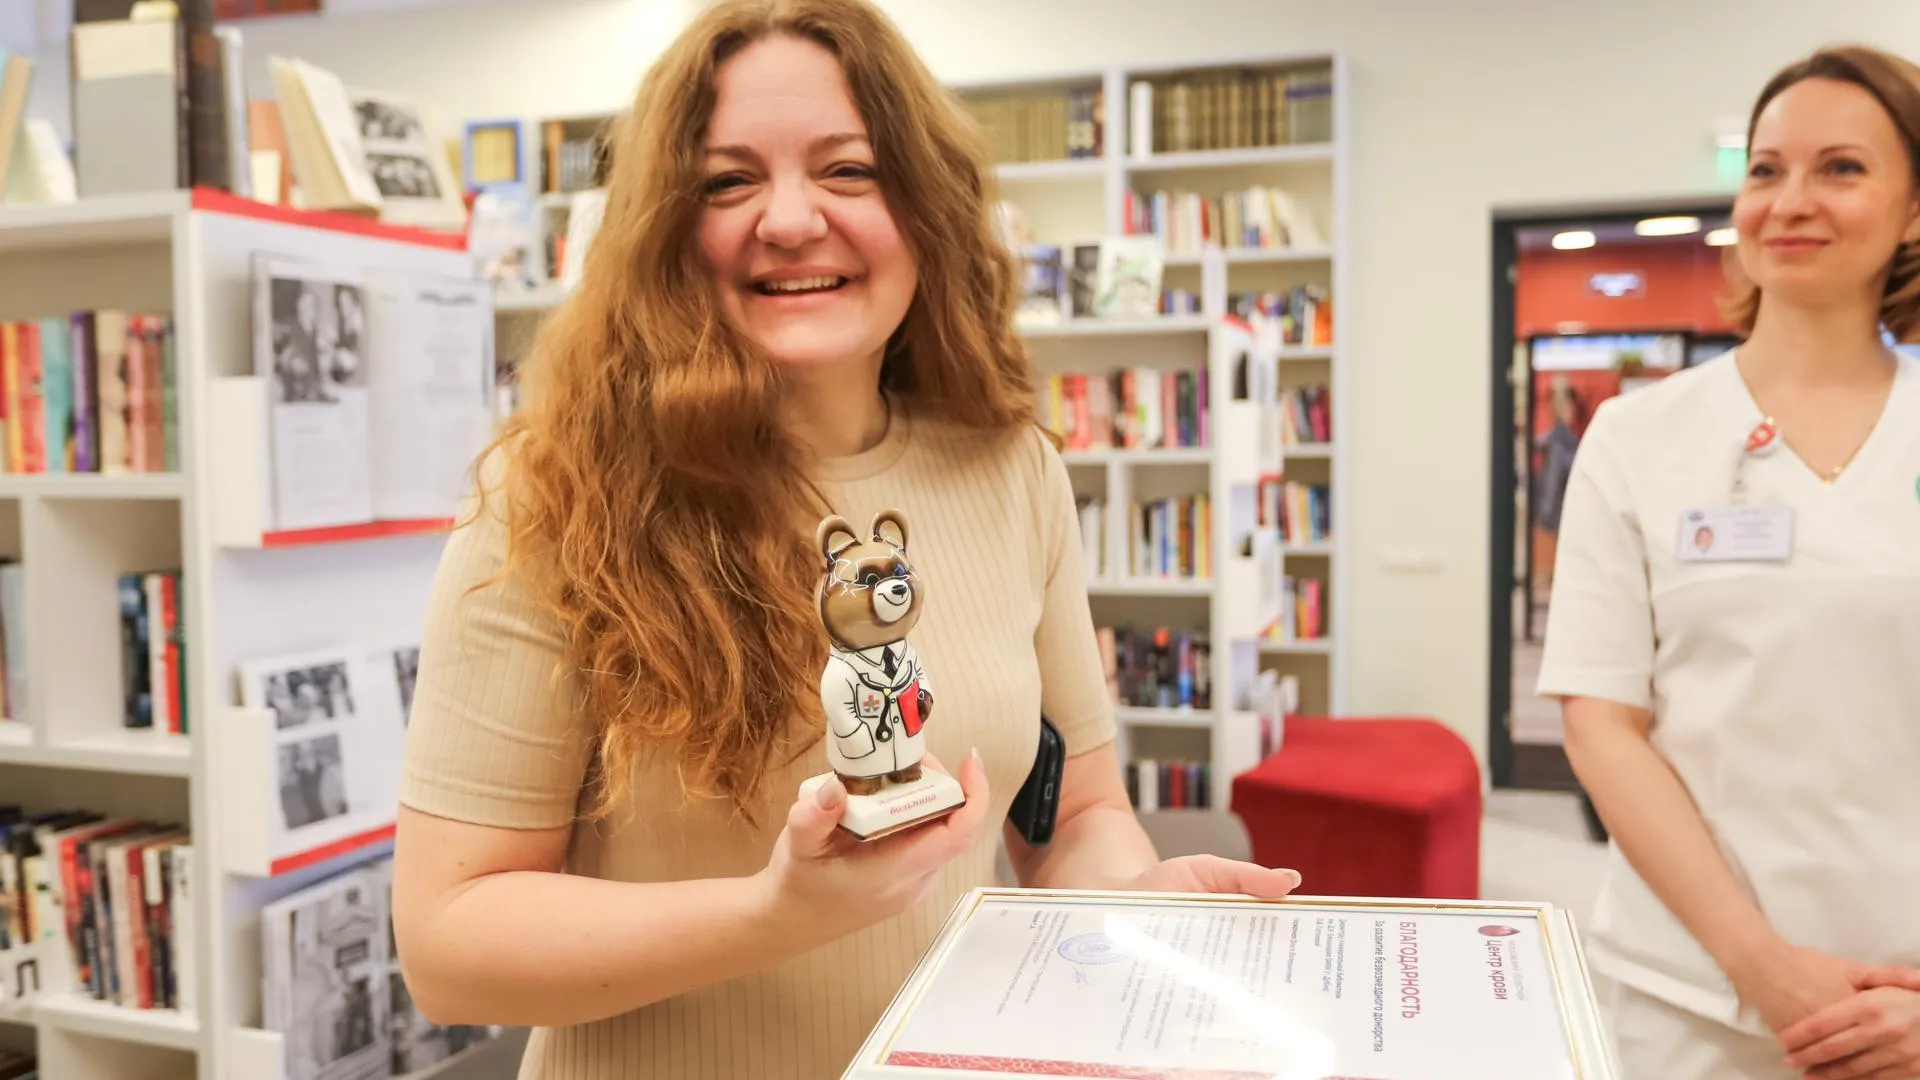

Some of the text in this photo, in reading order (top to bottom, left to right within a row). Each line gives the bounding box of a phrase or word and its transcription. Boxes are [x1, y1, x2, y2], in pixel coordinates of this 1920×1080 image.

[1373, 928, 1383, 955] развитие
[1373, 956, 1386, 1011] безвозмездного
[1398, 921, 1421, 1019] БЛАГОДАРНОСТЬ
[1485, 939, 1508, 1000] Центр крови
[1371, 1012, 1383, 1051] донорства
